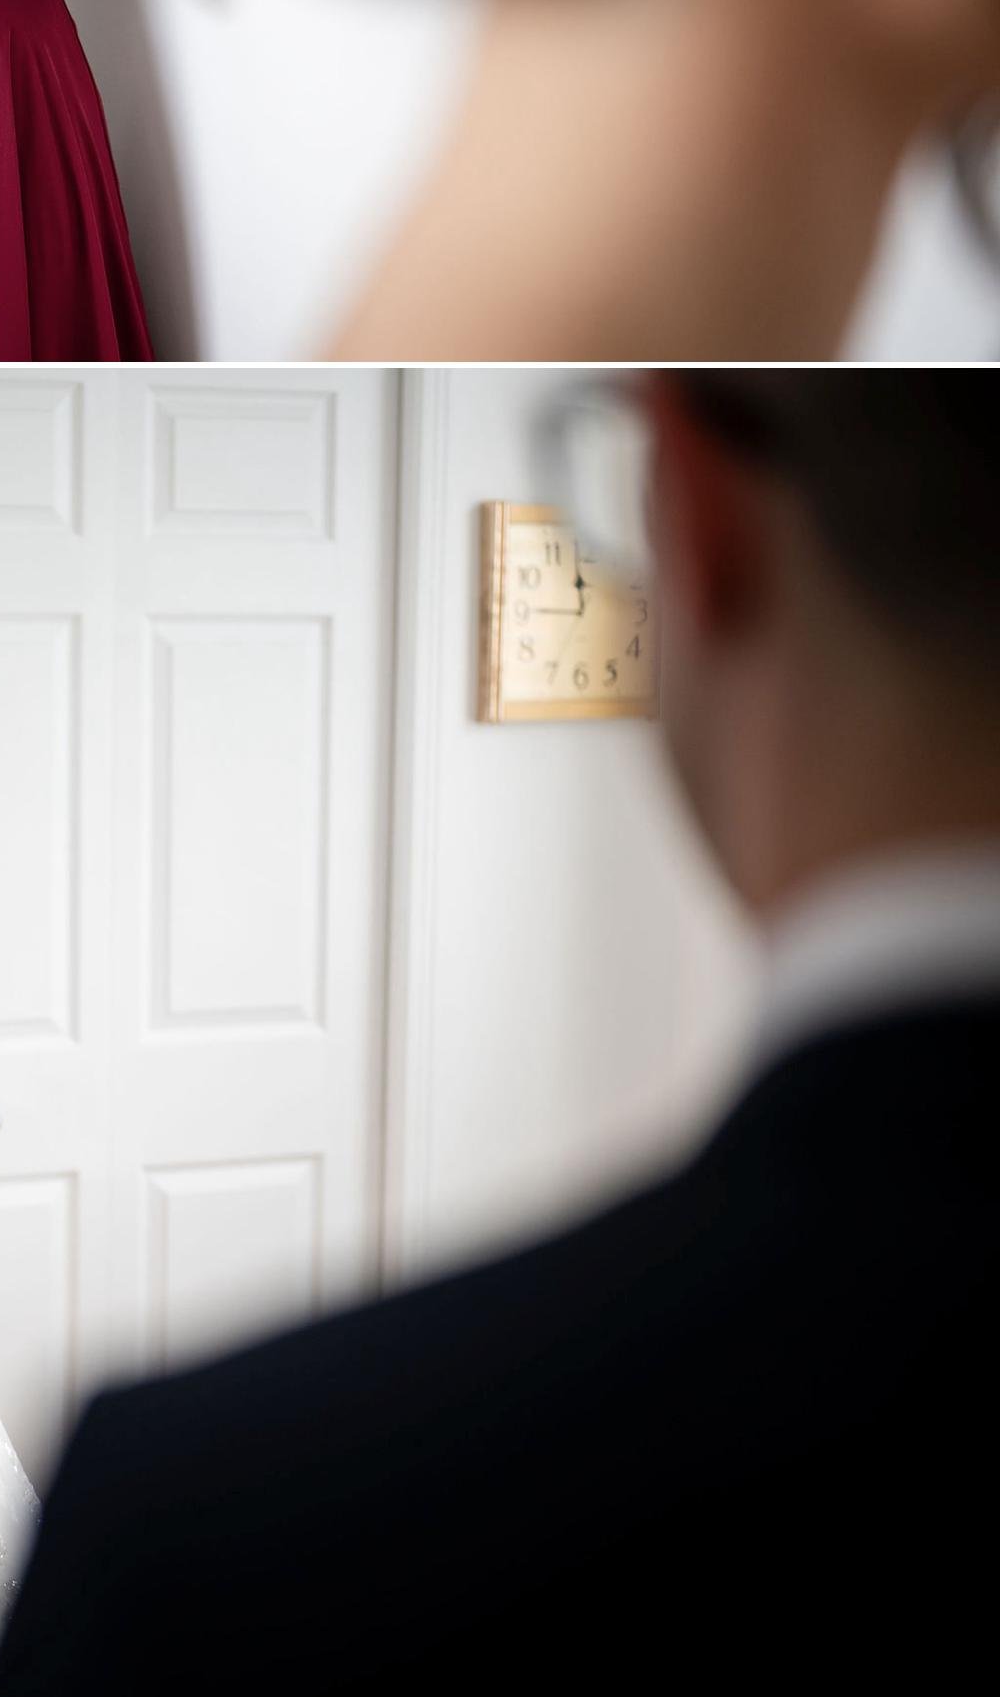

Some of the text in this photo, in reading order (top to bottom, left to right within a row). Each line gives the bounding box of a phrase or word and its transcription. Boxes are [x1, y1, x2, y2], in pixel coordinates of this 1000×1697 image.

[544, 540, 561, 566] 11
[517, 565, 541, 590] 10
[514, 598, 529, 626] 9
[632, 598, 649, 626] 3
[517, 636, 534, 662] 8
[626, 633, 642, 660] 4
[545, 660, 559, 685] 7
[573, 661, 589, 689] 6
[603, 658, 618, 688] 5
